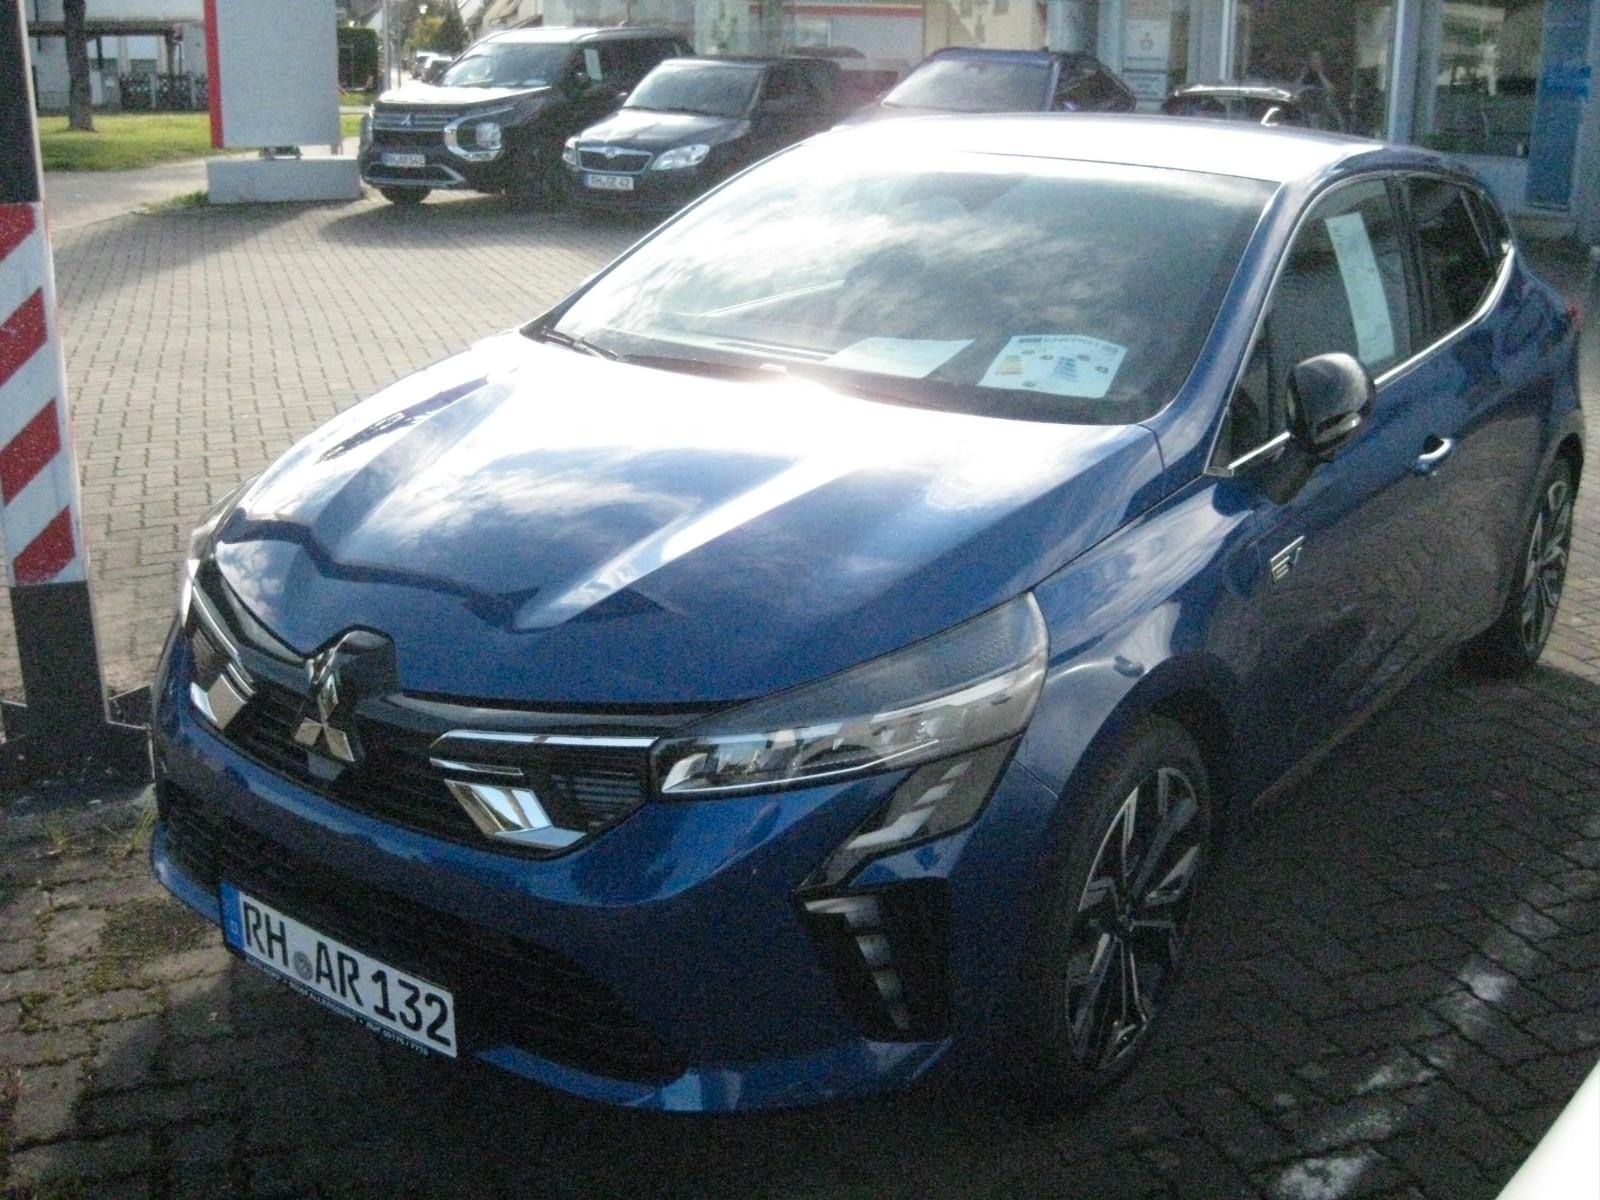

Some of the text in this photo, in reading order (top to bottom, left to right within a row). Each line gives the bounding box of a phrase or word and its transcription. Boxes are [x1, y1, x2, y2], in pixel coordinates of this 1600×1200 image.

[243, 900, 451, 1048] RH AR 132
